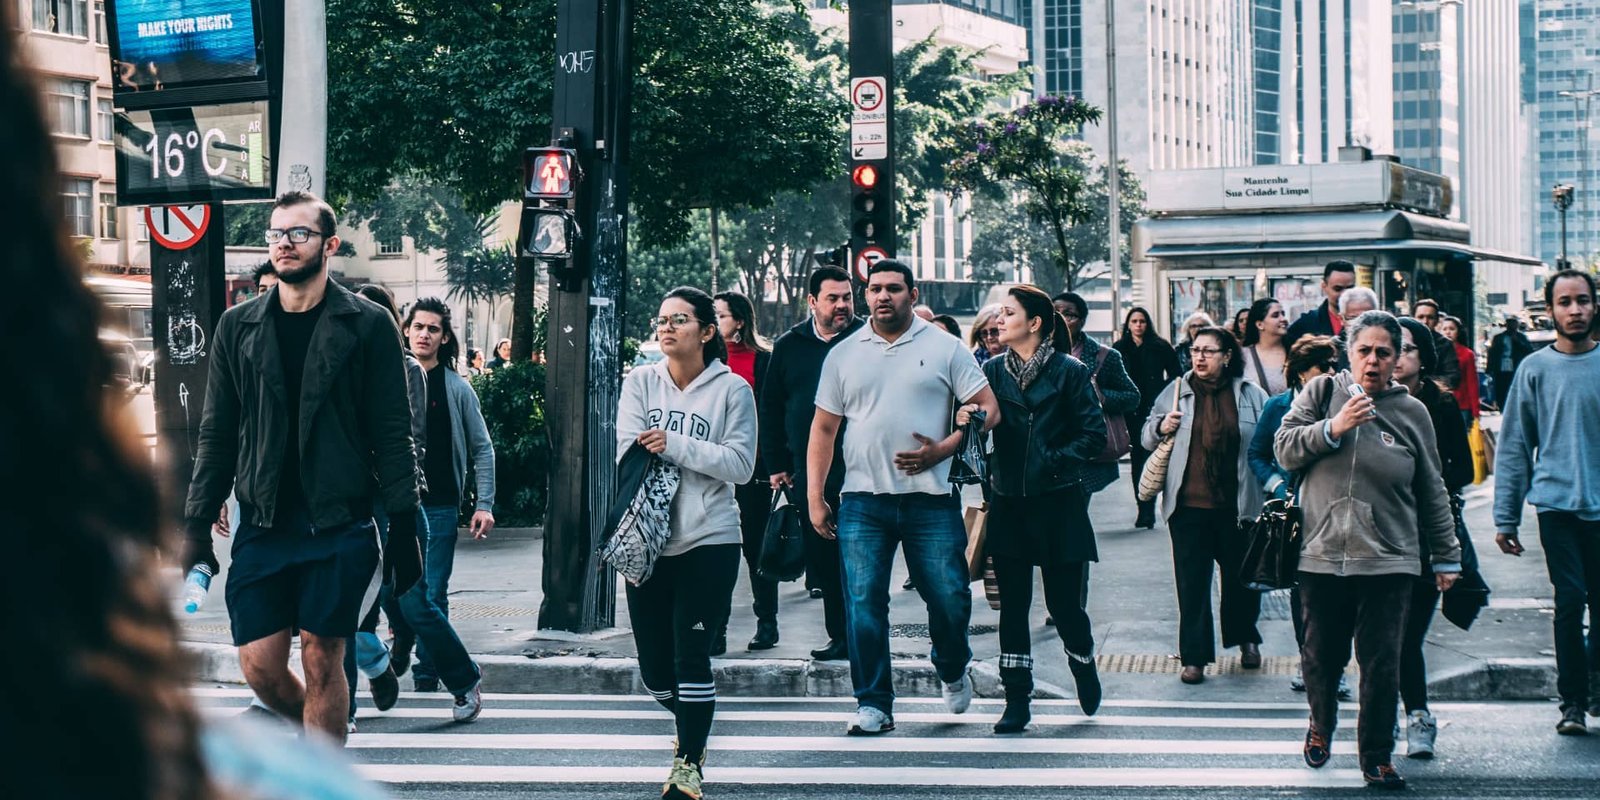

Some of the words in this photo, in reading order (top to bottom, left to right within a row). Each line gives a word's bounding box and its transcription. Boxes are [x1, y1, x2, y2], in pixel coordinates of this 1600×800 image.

[138, 21, 167, 38] MAKE
[167, 18, 196, 35] YOUR
[248, 120, 260, 133] AR
[146, 128, 228, 179] 16°C
[1243, 176, 1288, 185] Mantenha
[1225, 189, 1243, 198] Sua
[1245, 188, 1278, 197] Cidade
[1280, 187, 1309, 196] Limpa
